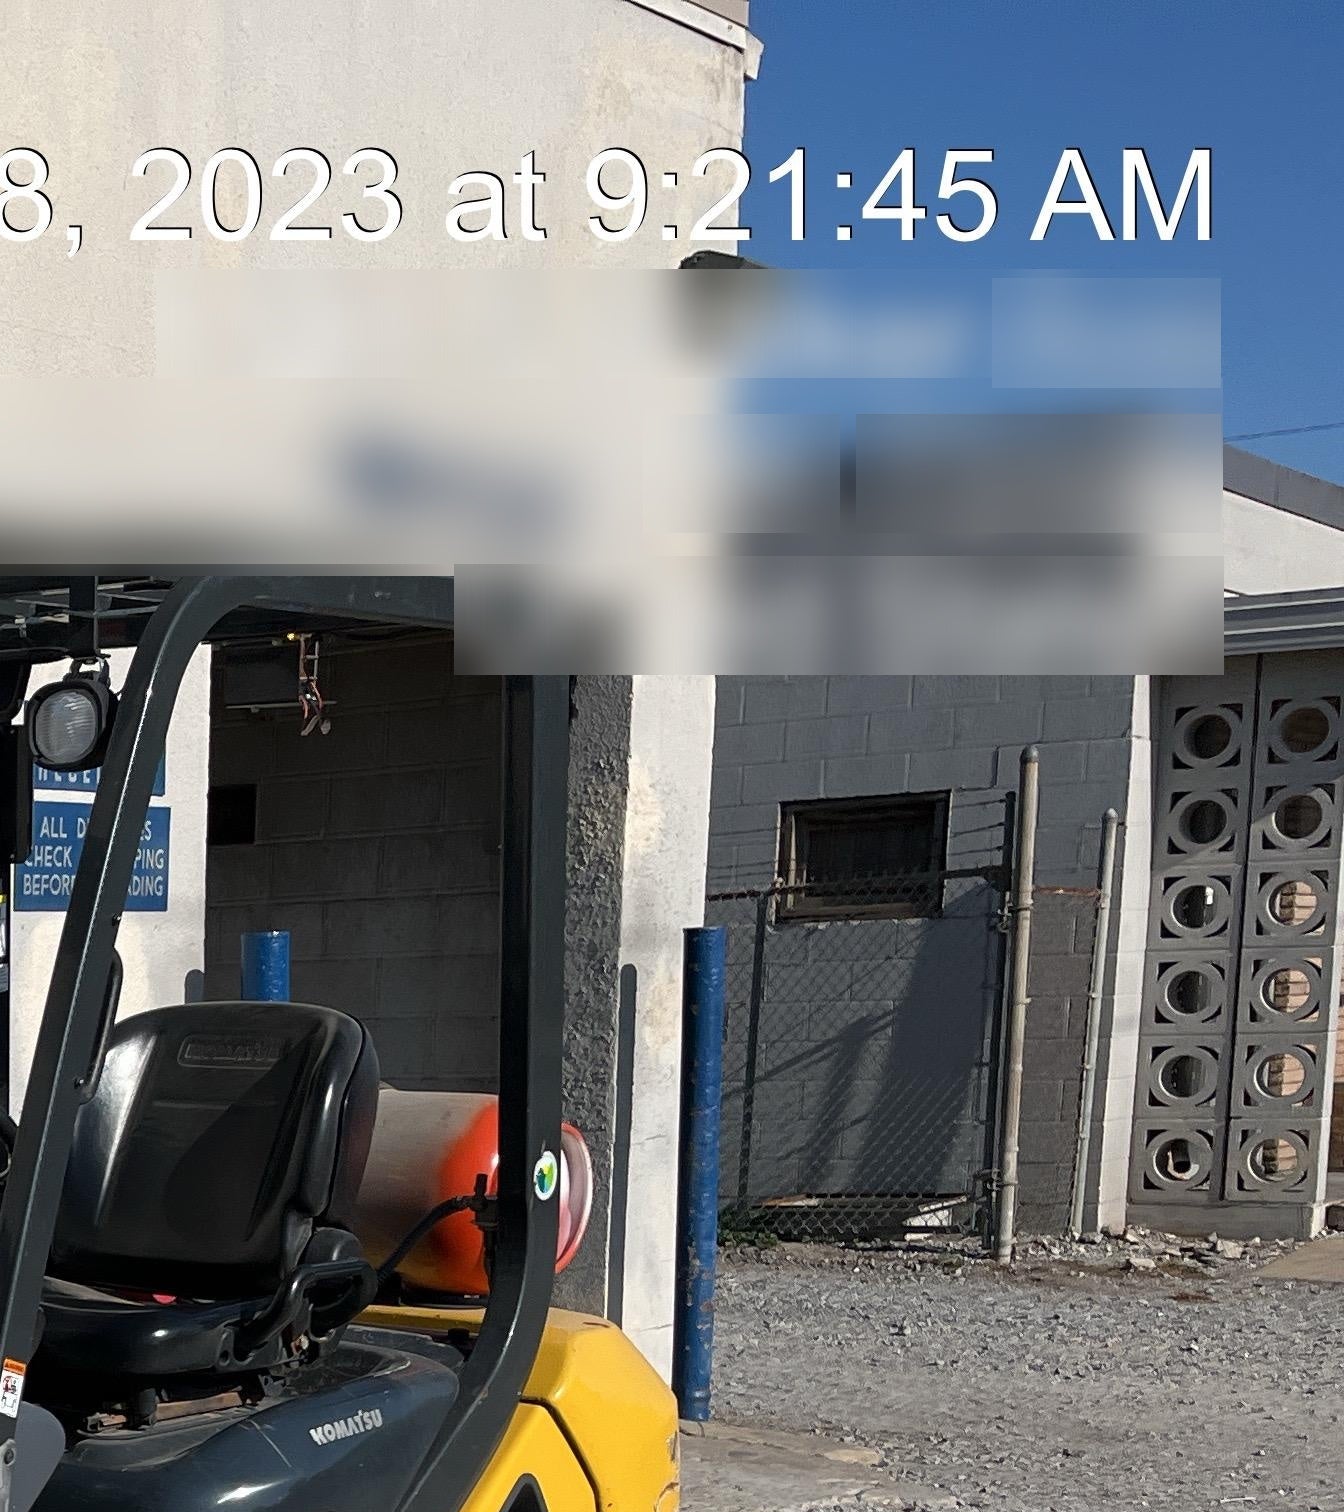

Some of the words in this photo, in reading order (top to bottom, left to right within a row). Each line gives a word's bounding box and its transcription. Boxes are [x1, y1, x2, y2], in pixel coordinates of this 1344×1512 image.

[39, 816, 68, 839] ALL
[22, 873, 76, 896] BEFOR
[309, 1408, 383, 1446] KOMATSU
